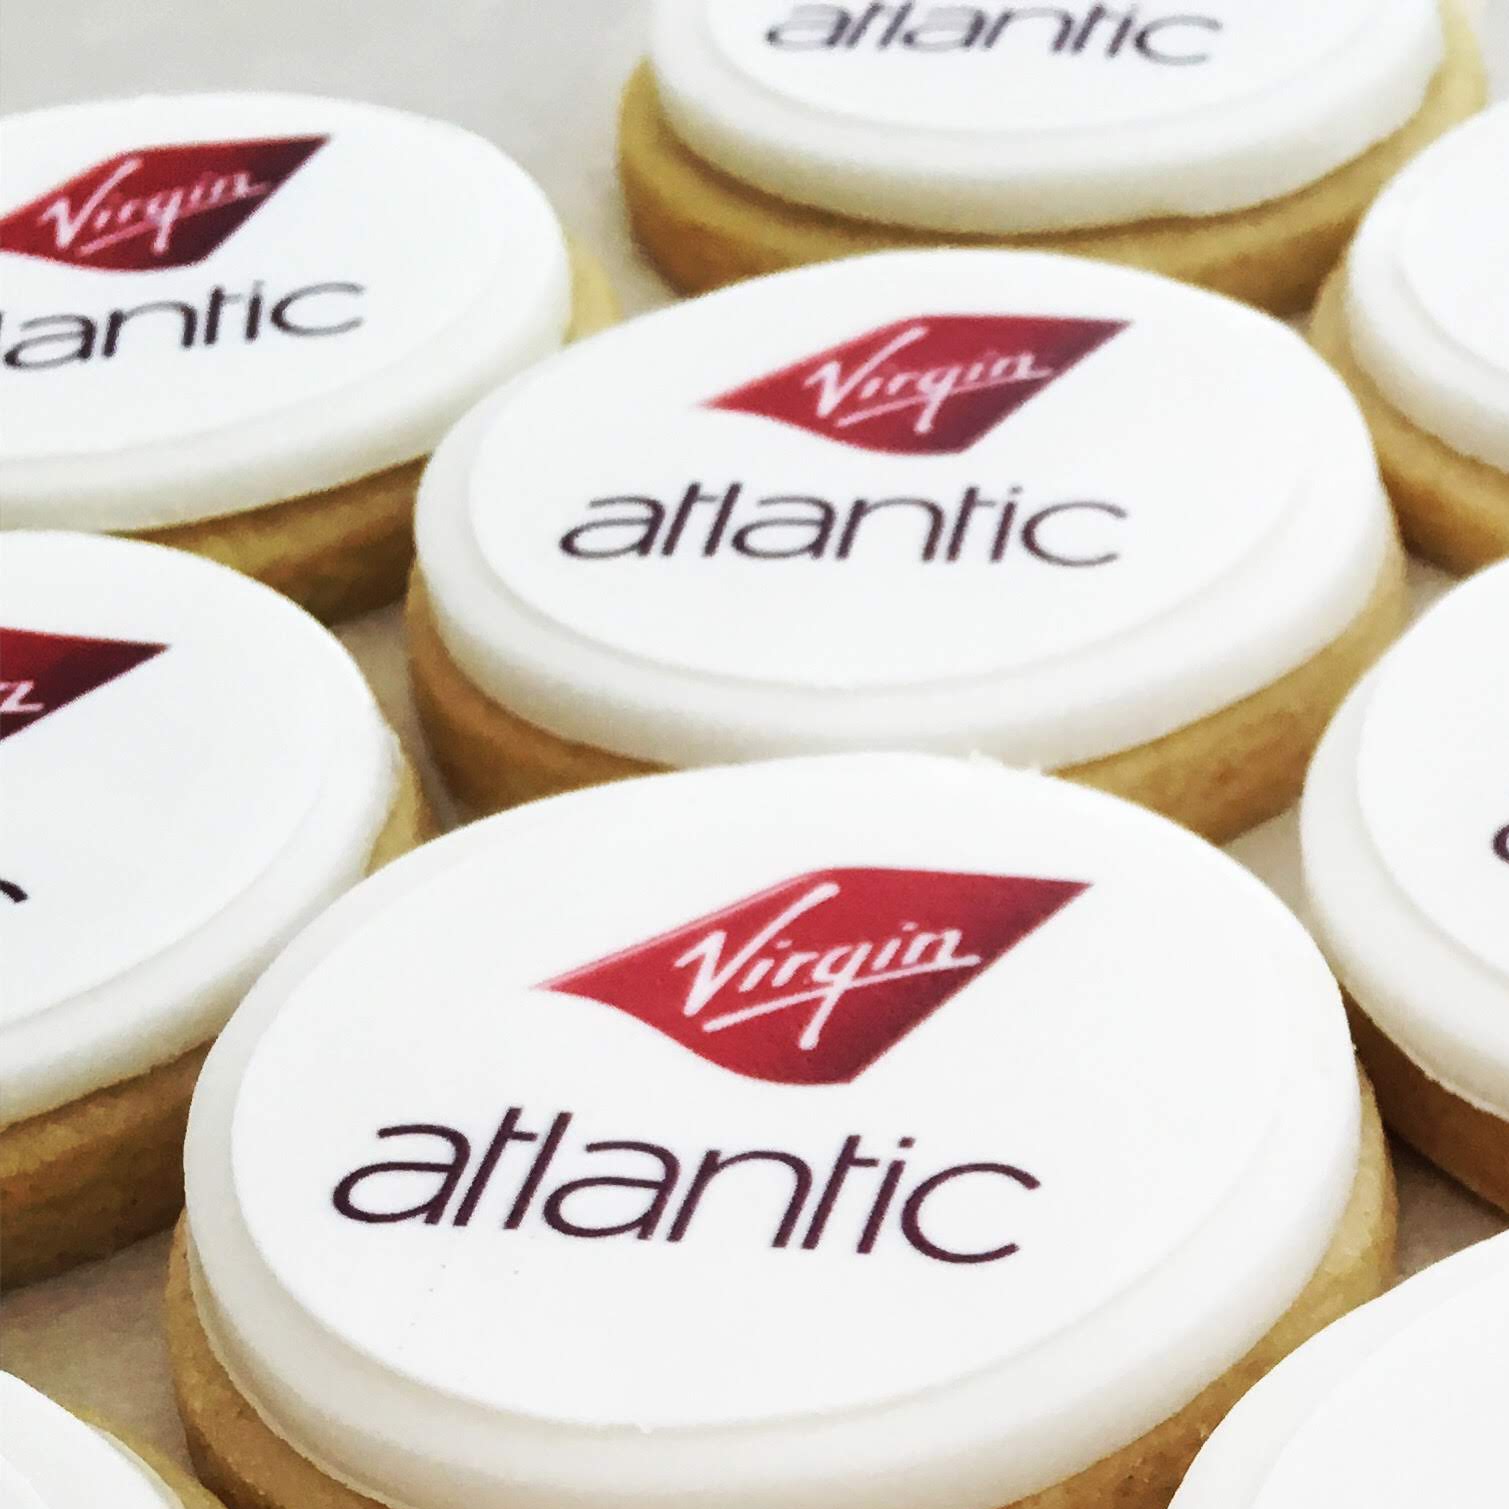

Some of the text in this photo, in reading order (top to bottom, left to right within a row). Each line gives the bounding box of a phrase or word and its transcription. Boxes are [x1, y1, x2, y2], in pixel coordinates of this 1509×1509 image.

[765, 0, 1222, 65] atlantic
[40, 156, 270, 255] Virgin
[0, 281, 365, 371] antic
[804, 326, 1054, 434] Virgin
[557, 481, 1128, 568] atlantic
[673, 880, 983, 1051] Virgin
[329, 1105, 1043, 1266] atlantic
